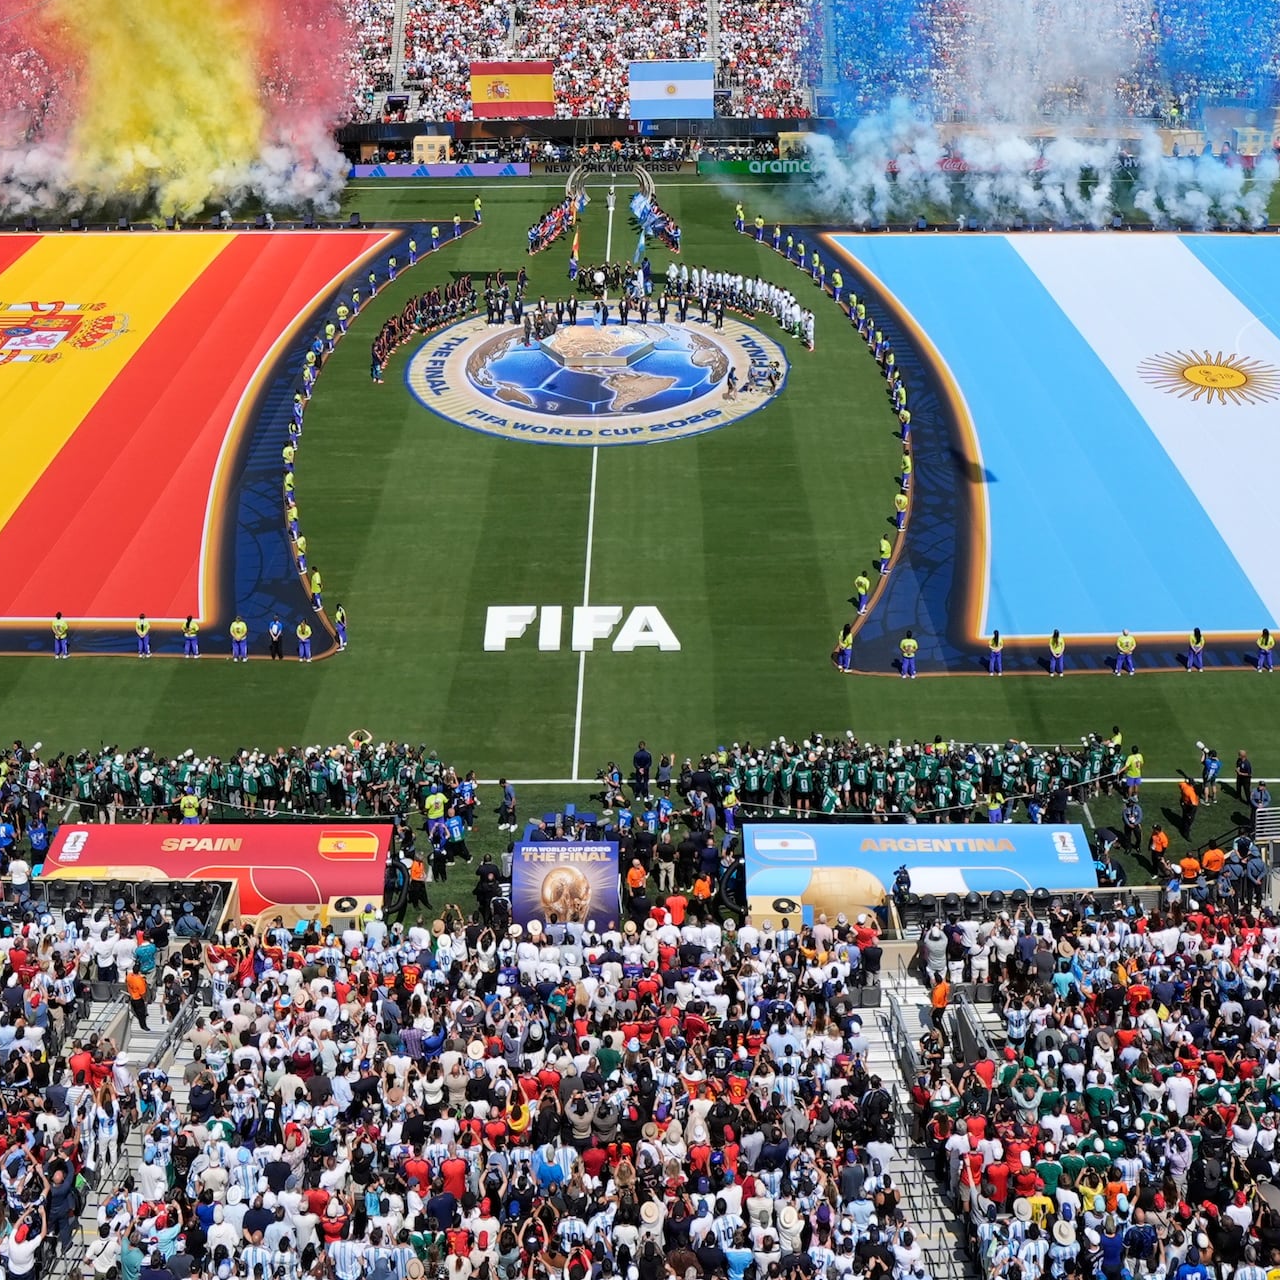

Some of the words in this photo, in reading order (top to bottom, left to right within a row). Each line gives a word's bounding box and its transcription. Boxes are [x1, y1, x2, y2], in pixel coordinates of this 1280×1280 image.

[545, 163, 569, 173] NEW
[608, 163, 635, 173] NEW
[749, 159, 812, 173] aramc
[432, 334, 470, 358] THE
[735, 334, 769, 368] FINAL
[425, 358, 451, 397] FINAL
[466, 408, 509, 427] FIFA
[513, 421, 594, 437] WORLD
[598, 425, 644, 437] CUP
[648, 408, 723, 432] 2026
[483, 606, 681, 652] FIFA
[160, 838, 242, 852] SPAIN
[860, 838, 1017, 852] ARGENTINA
[522, 852, 556, 862] THE
[558, 852, 611, 862] FINAL
[714, 1057, 726, 1070] 10
[721, 1227, 734, 1241] 10
